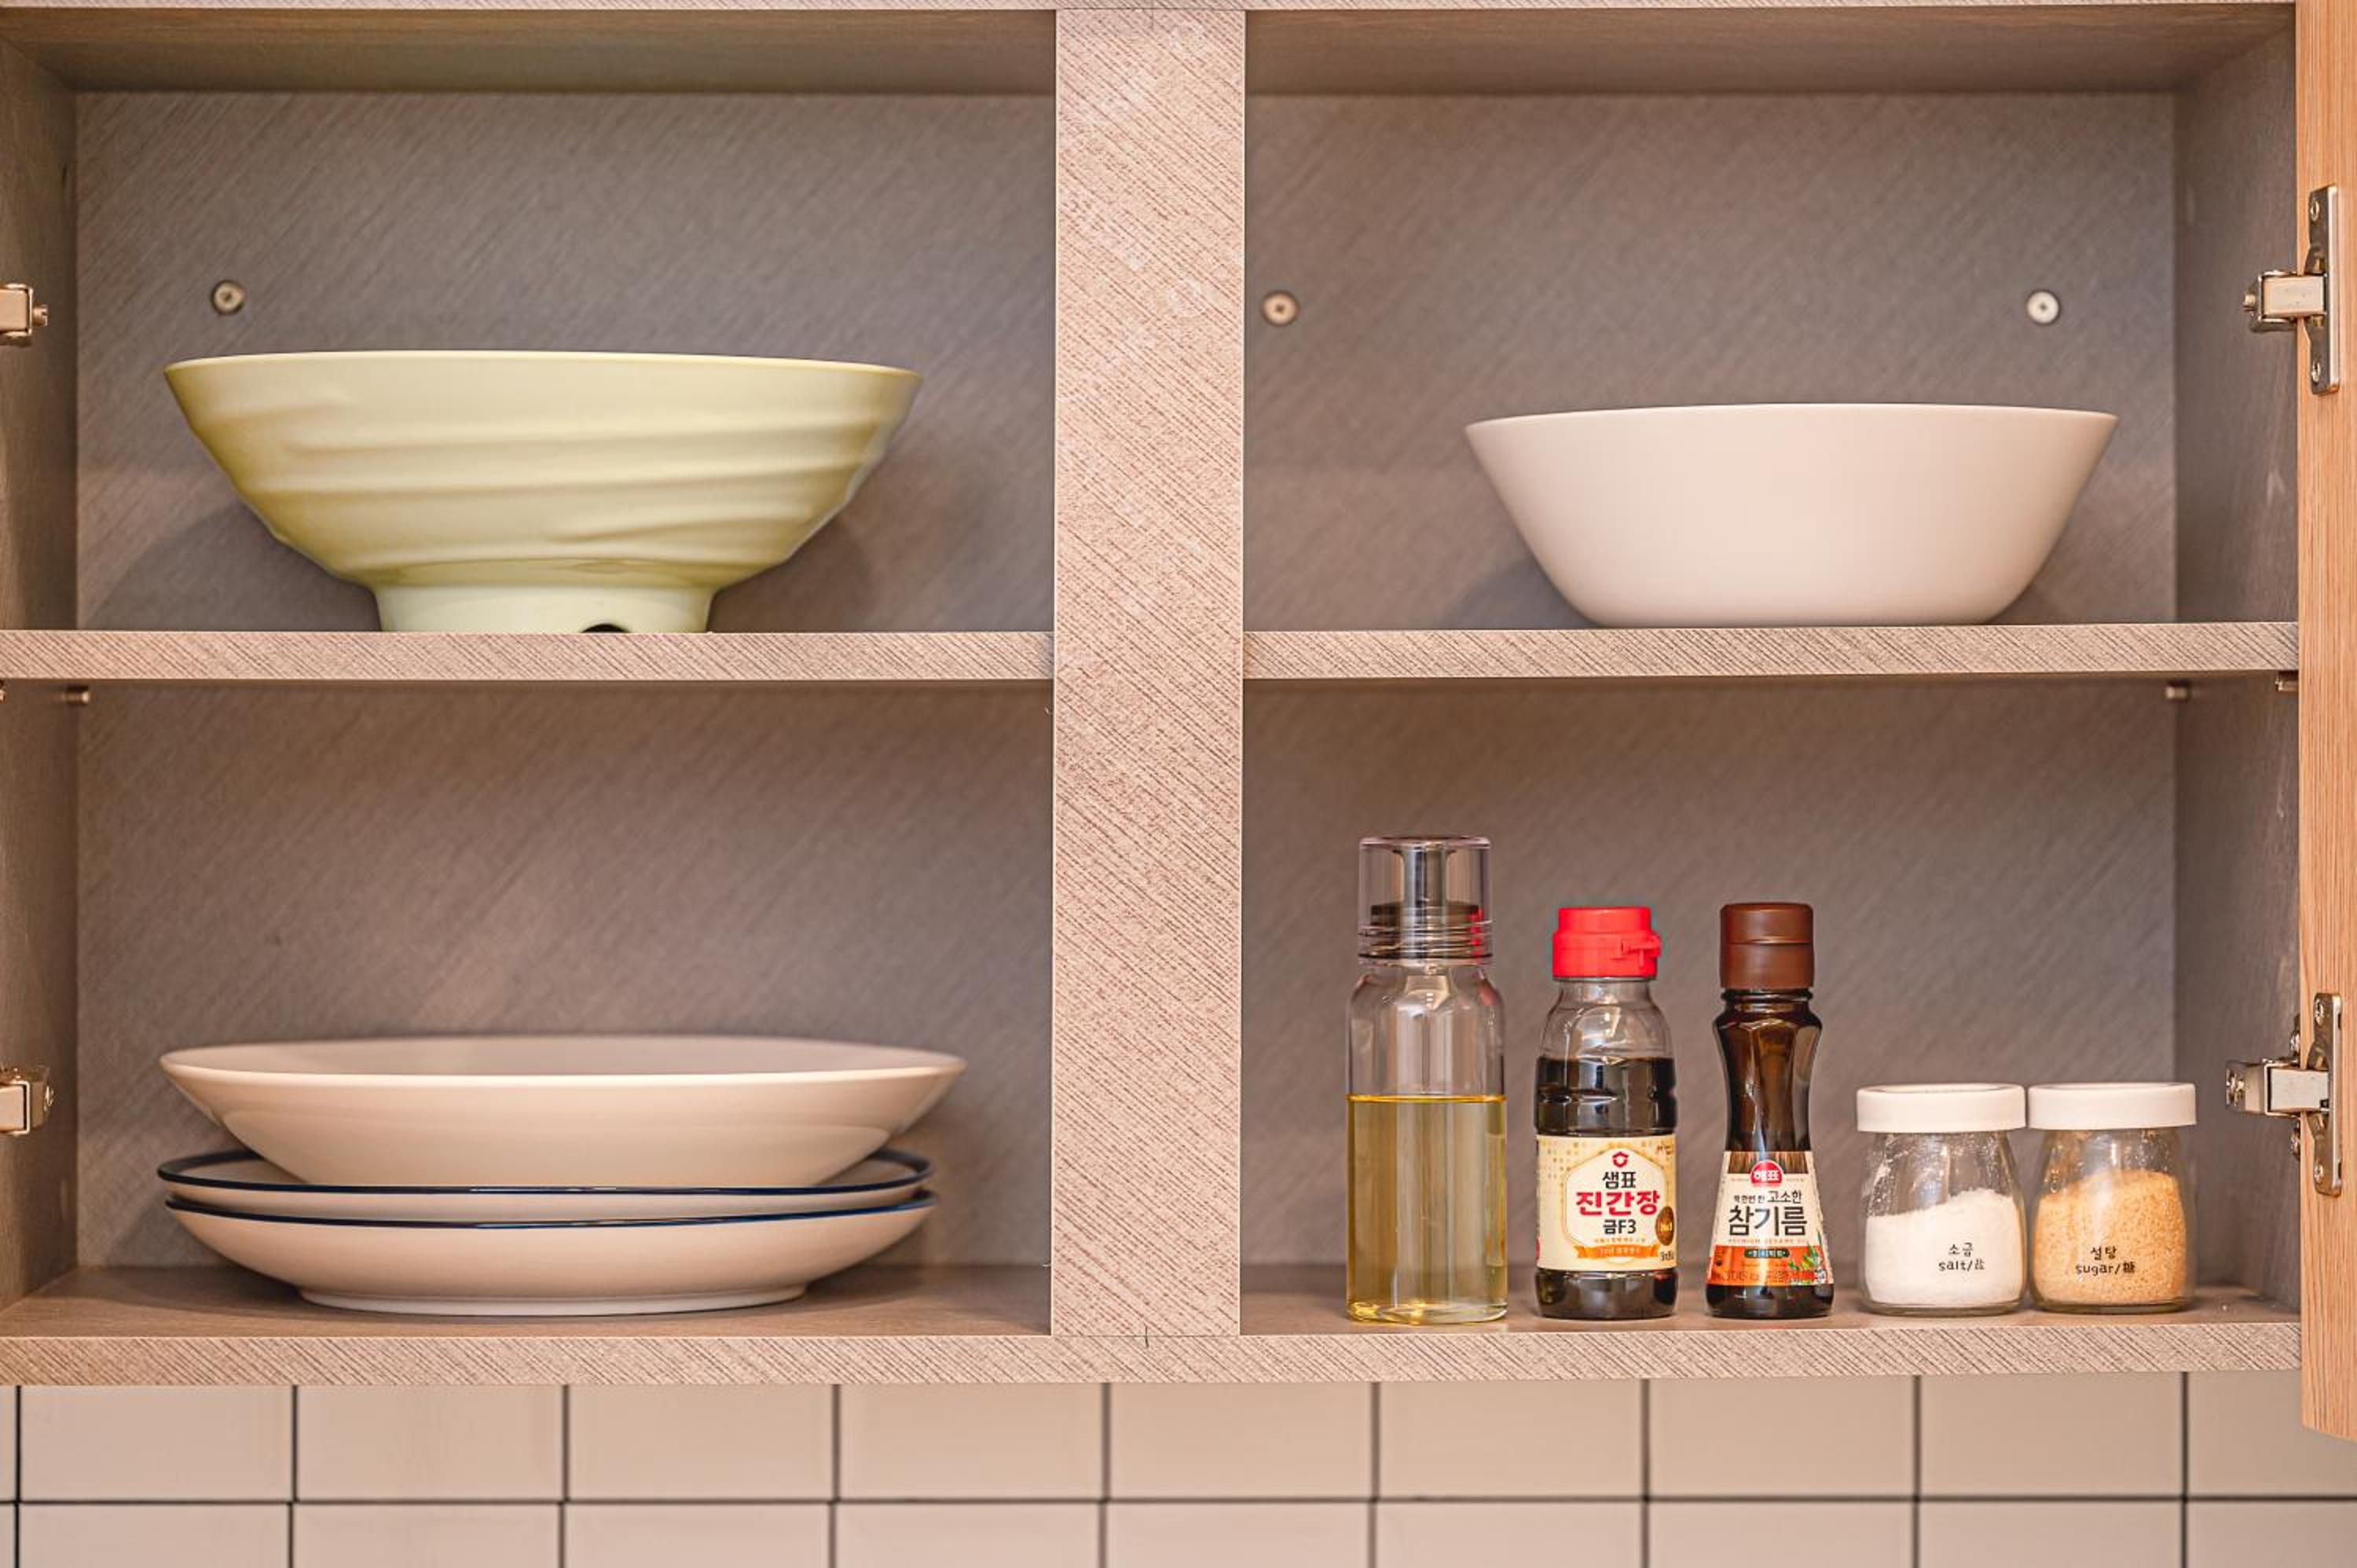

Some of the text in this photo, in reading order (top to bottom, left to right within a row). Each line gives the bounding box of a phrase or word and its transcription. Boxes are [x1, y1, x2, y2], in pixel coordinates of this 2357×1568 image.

[1602, 1171, 1636, 1189] 샘표
[1753, 1170, 1780, 1181] 해표
[1576, 1190, 1660, 1216] 진간장
[1767, 1189, 1802, 1203] 고소한
[1603, 1218, 1637, 1234] 금F3
[1728, 1204, 1807, 1236] 참기름
[1948, 1242, 1974, 1258] 소금
[2090, 1245, 2117, 1261] 설탕
